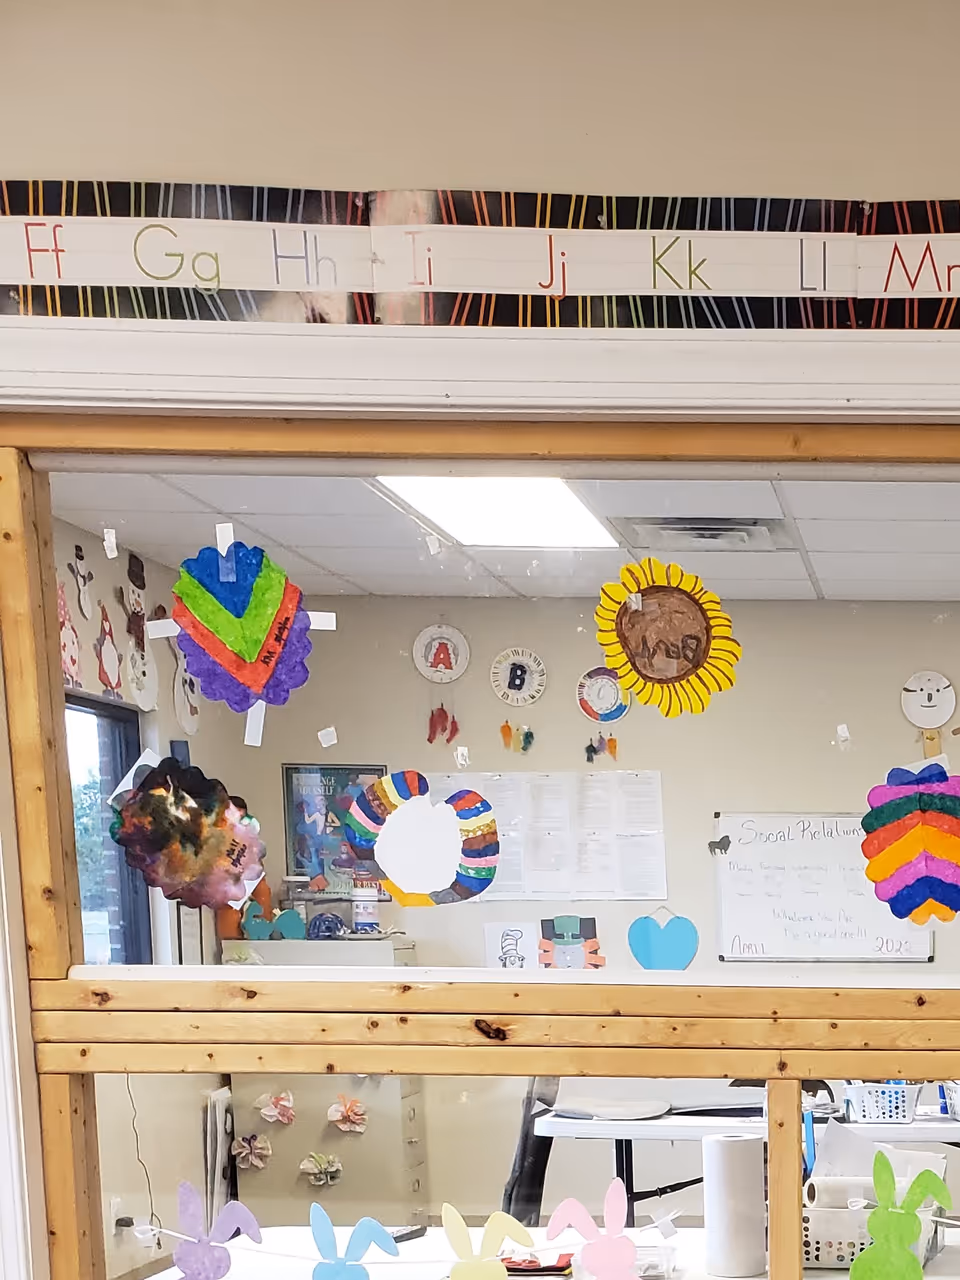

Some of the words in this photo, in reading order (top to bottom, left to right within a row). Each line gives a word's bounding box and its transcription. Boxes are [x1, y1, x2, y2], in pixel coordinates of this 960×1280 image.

[24, 222, 66, 279] Ff
[133, 223, 220, 295] Gg
[271, 228, 338, 287] Hh
[404, 231, 434, 288] Ii
[538, 235, 568, 299] Jj
[651, 236, 713, 290] Kk
[507, 662, 528, 691] B
